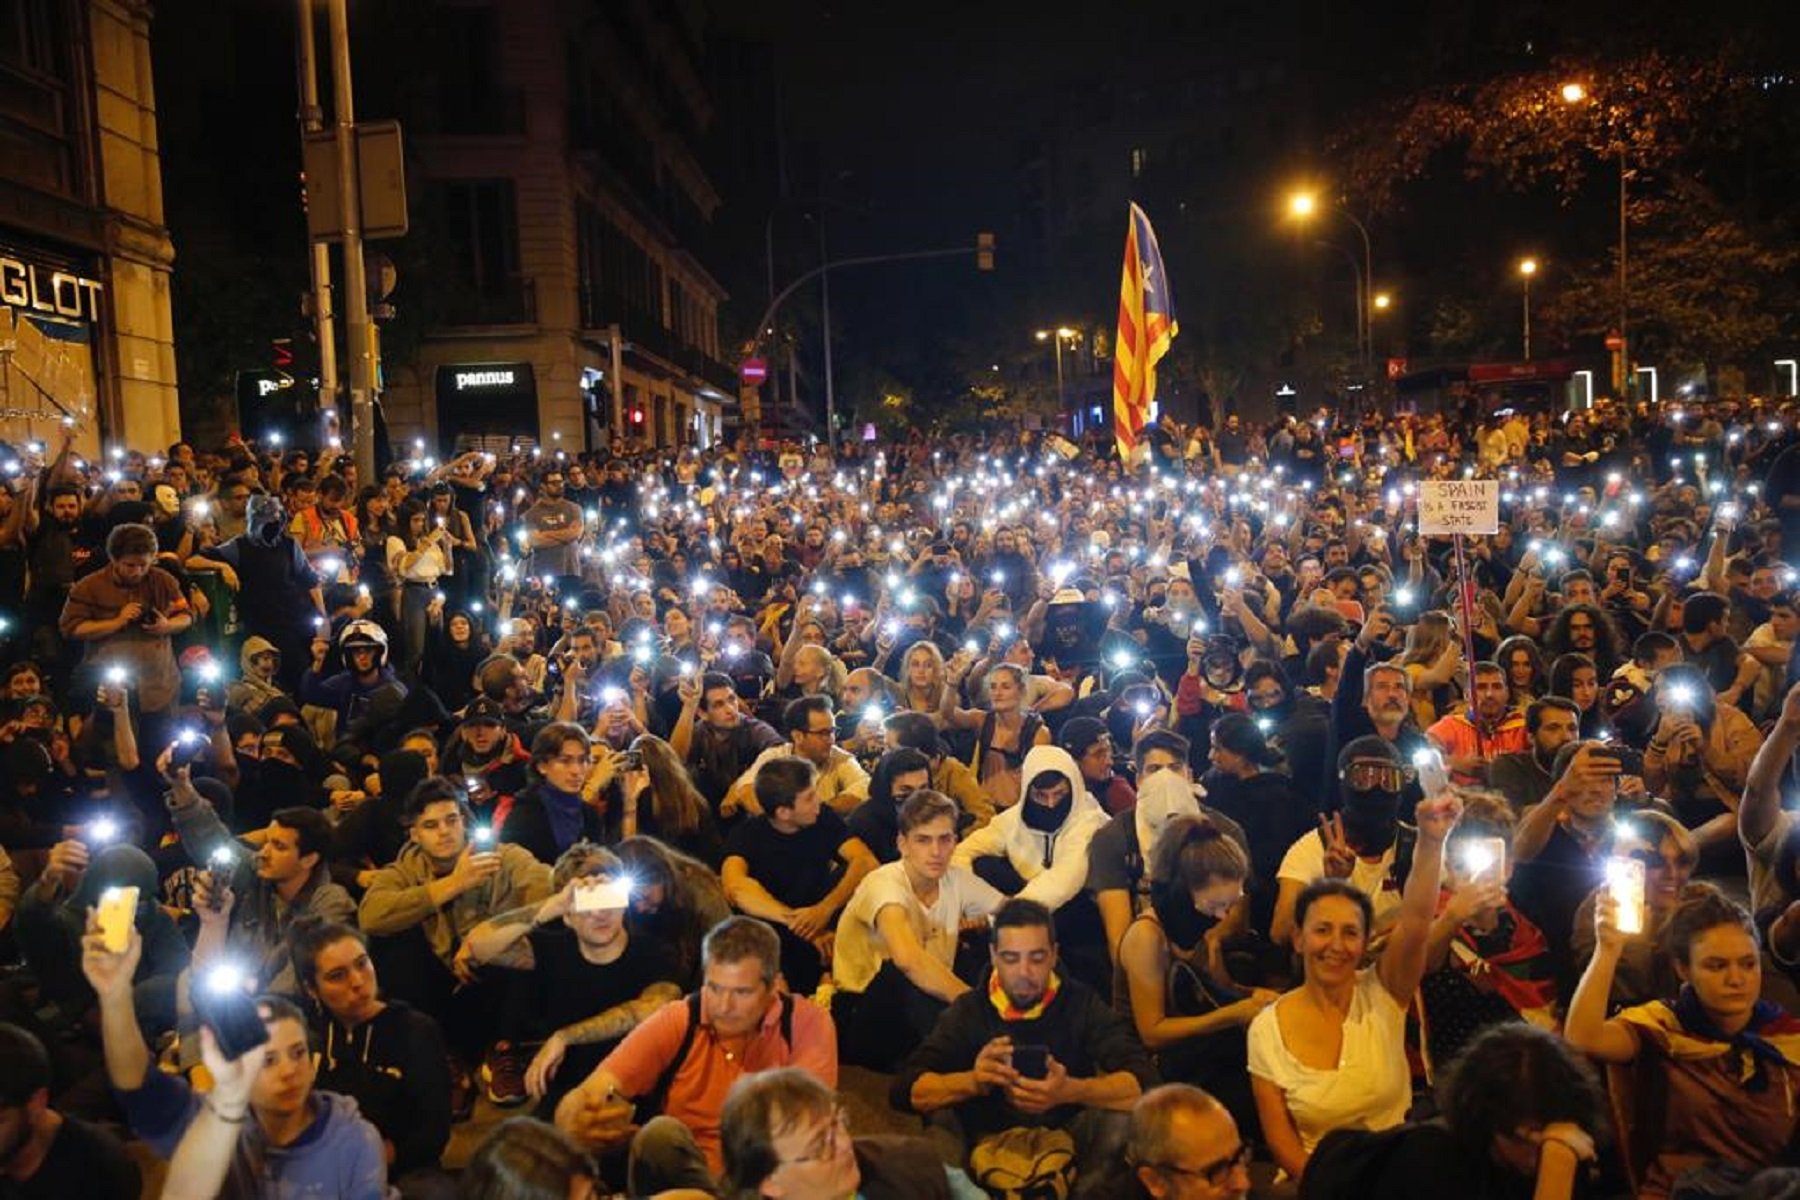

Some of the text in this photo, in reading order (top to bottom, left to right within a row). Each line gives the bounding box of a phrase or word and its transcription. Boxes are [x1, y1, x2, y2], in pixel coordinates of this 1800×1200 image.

[0, 258, 102, 321] GLOT
[456, 371, 514, 390] pannus
[1438, 482, 1486, 498] SPAIN
